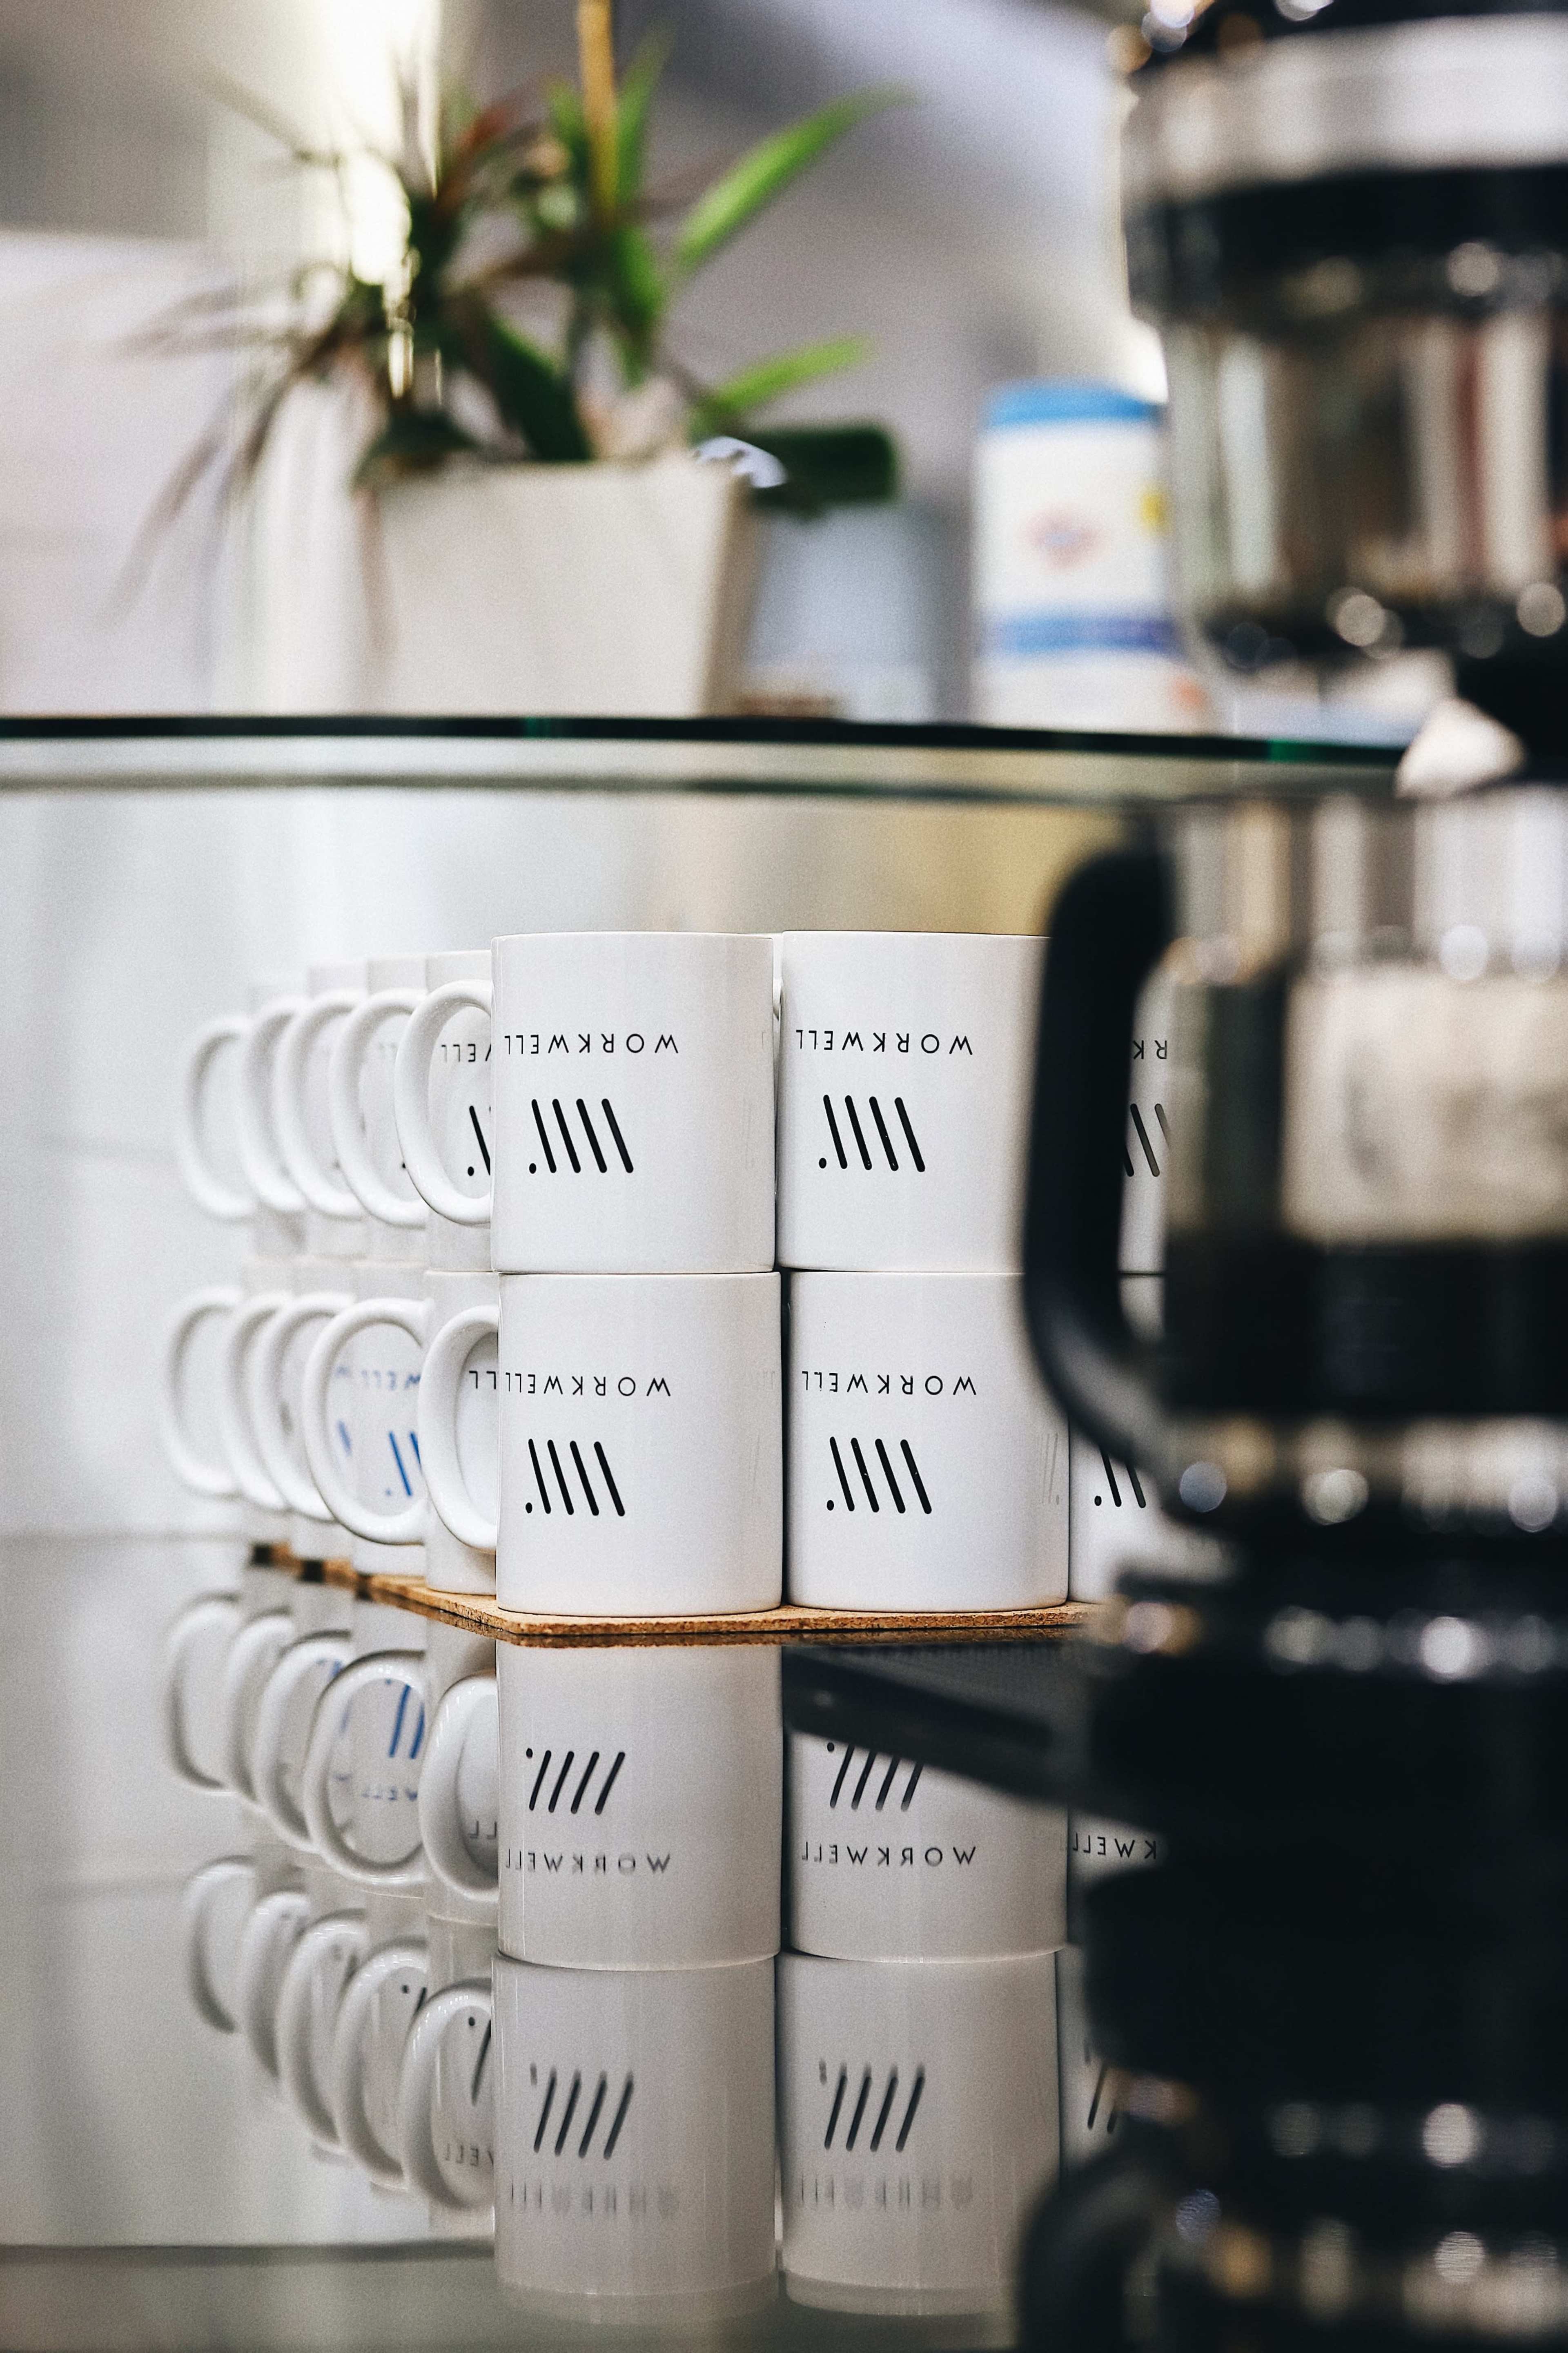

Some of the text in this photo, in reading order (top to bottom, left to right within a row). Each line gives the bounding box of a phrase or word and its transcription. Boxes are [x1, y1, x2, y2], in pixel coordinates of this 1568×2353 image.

[504, 1033, 679, 1055] WORKWELL
[795, 1029, 973, 1055] WORKWELL
[505, 1372, 671, 1397] WORKWELL
[802, 1371, 977, 1396] WORKWELL
